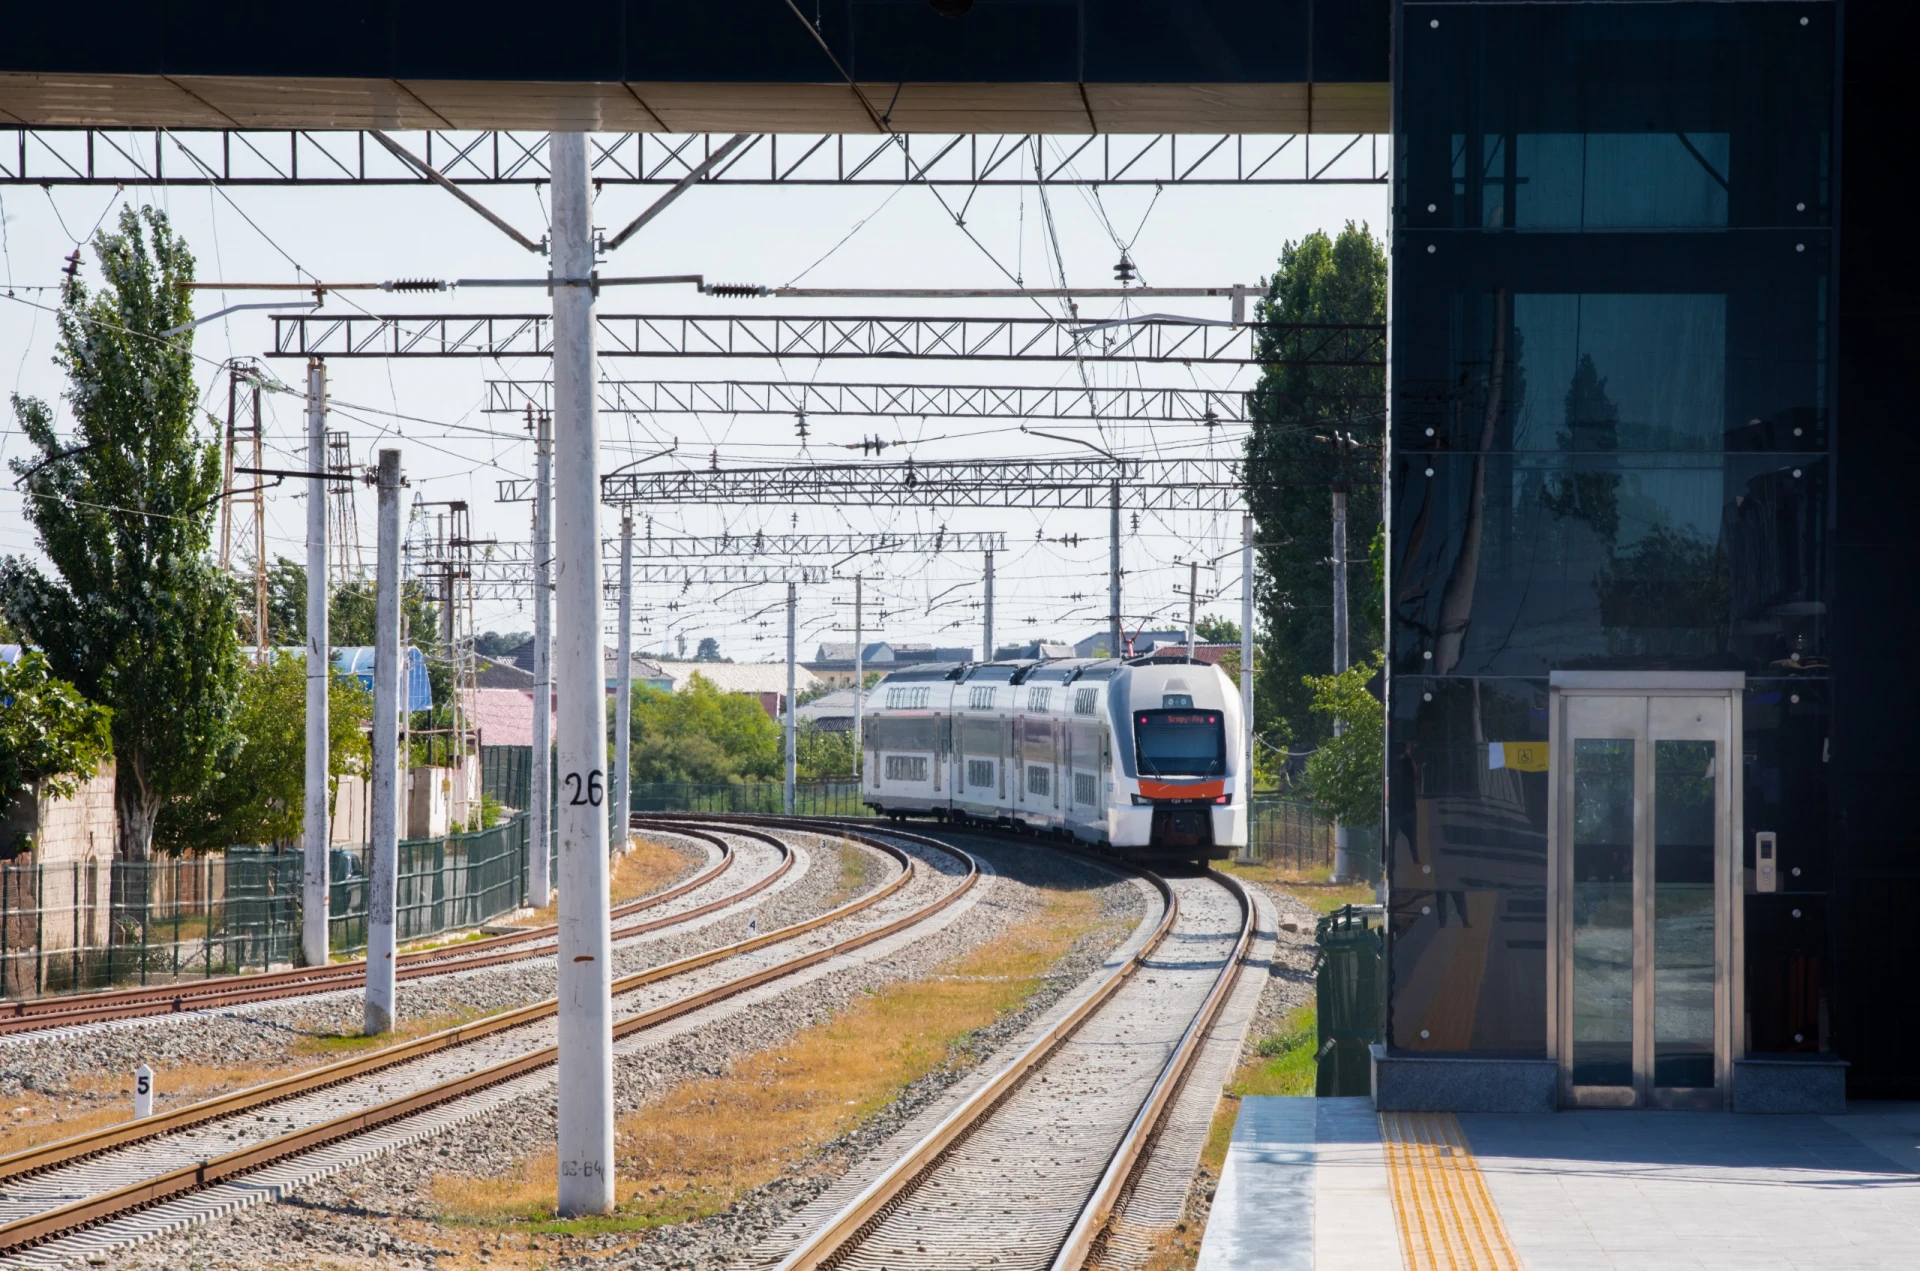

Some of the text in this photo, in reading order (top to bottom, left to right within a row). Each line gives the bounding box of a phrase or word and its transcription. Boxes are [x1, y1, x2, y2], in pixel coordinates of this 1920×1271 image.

[565, 769, 604, 807] 26
[749, 920, 756, 931] 4
[137, 1076, 150, 1095] 5
